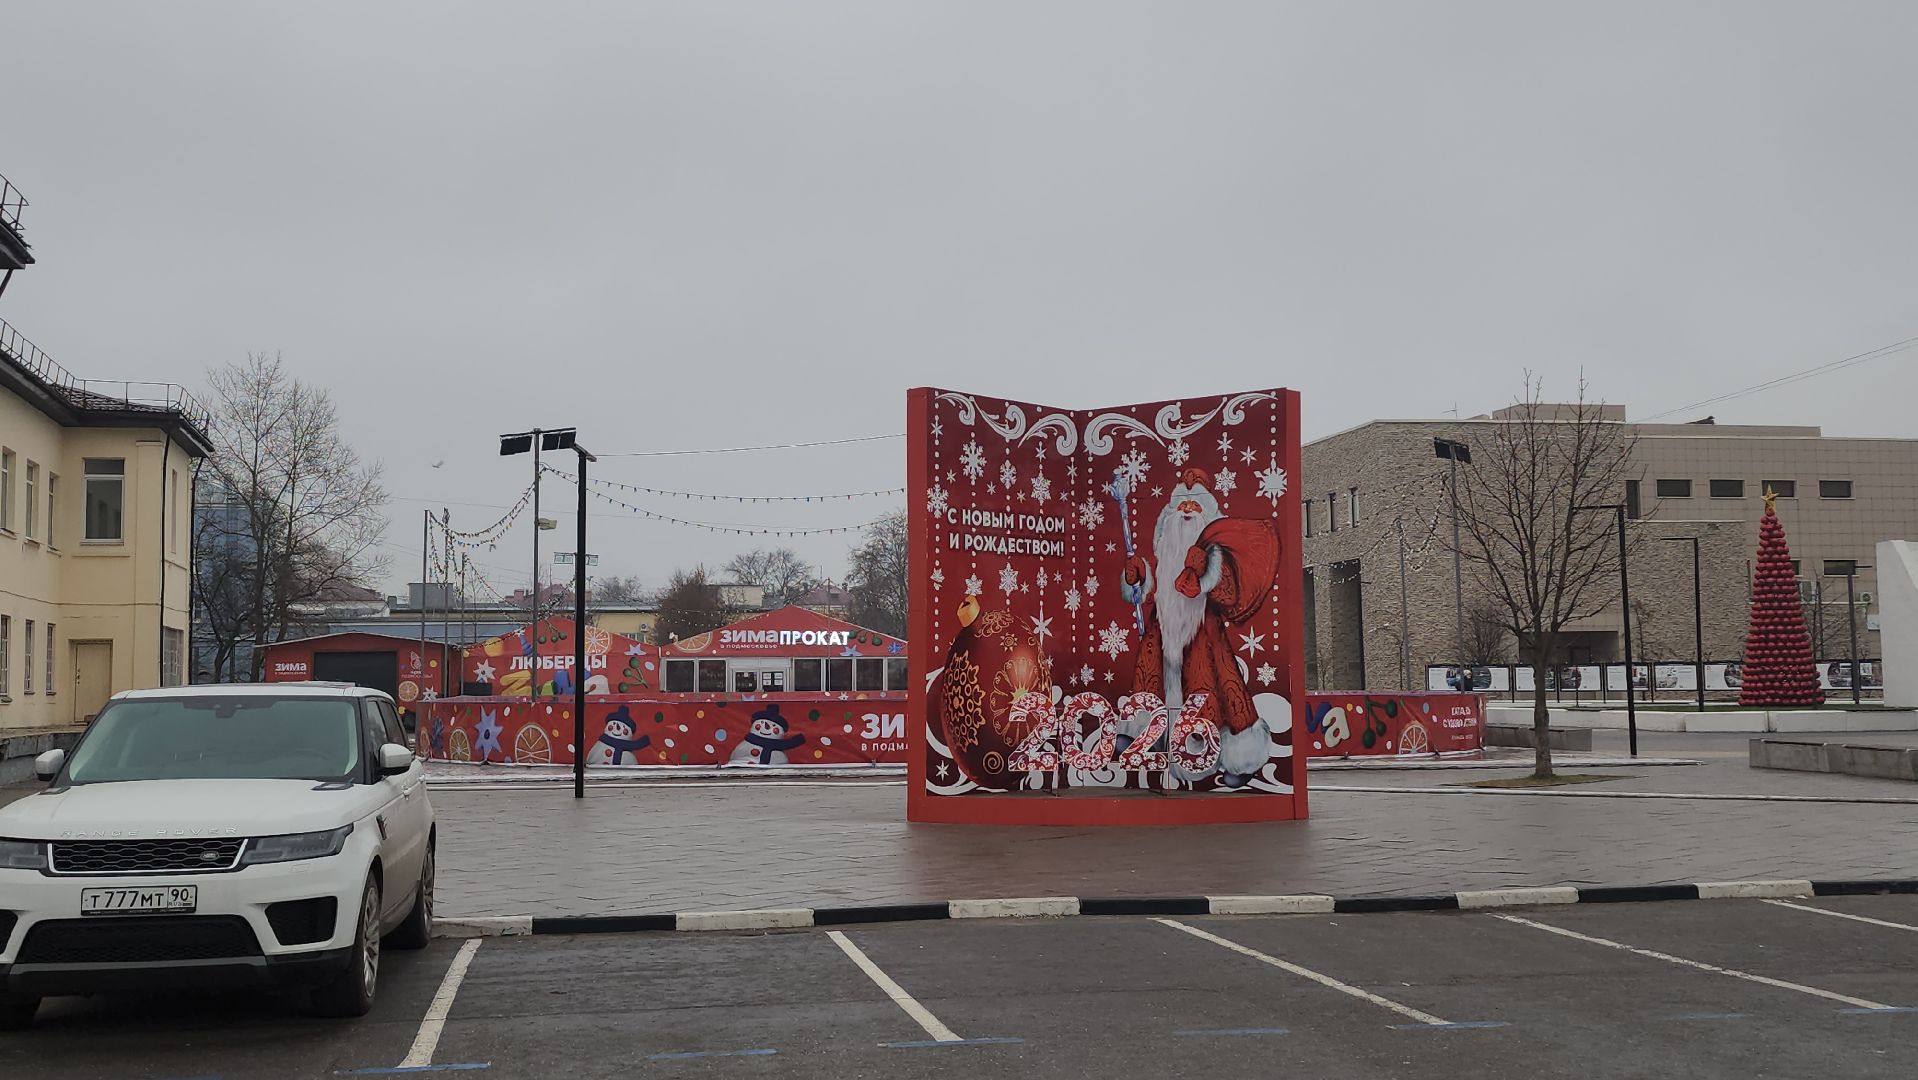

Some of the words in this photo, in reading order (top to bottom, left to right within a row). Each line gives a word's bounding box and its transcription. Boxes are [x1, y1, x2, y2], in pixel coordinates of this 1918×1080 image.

[947, 507, 958, 524] С
[962, 508, 1015, 529] НОВЫМ
[1019, 513, 1065, 534] ГОДОМ
[949, 532, 960, 549] И
[964, 533, 1065, 557] РОЖДЕСТВОМ!
[779, 630, 850, 645] ПРОКАТ
[1008, 692, 1222, 773] 2026
[60, 829, 140, 838] RANGE
[156, 826, 238, 836] ROVER
[171, 888, 189, 902] 90
